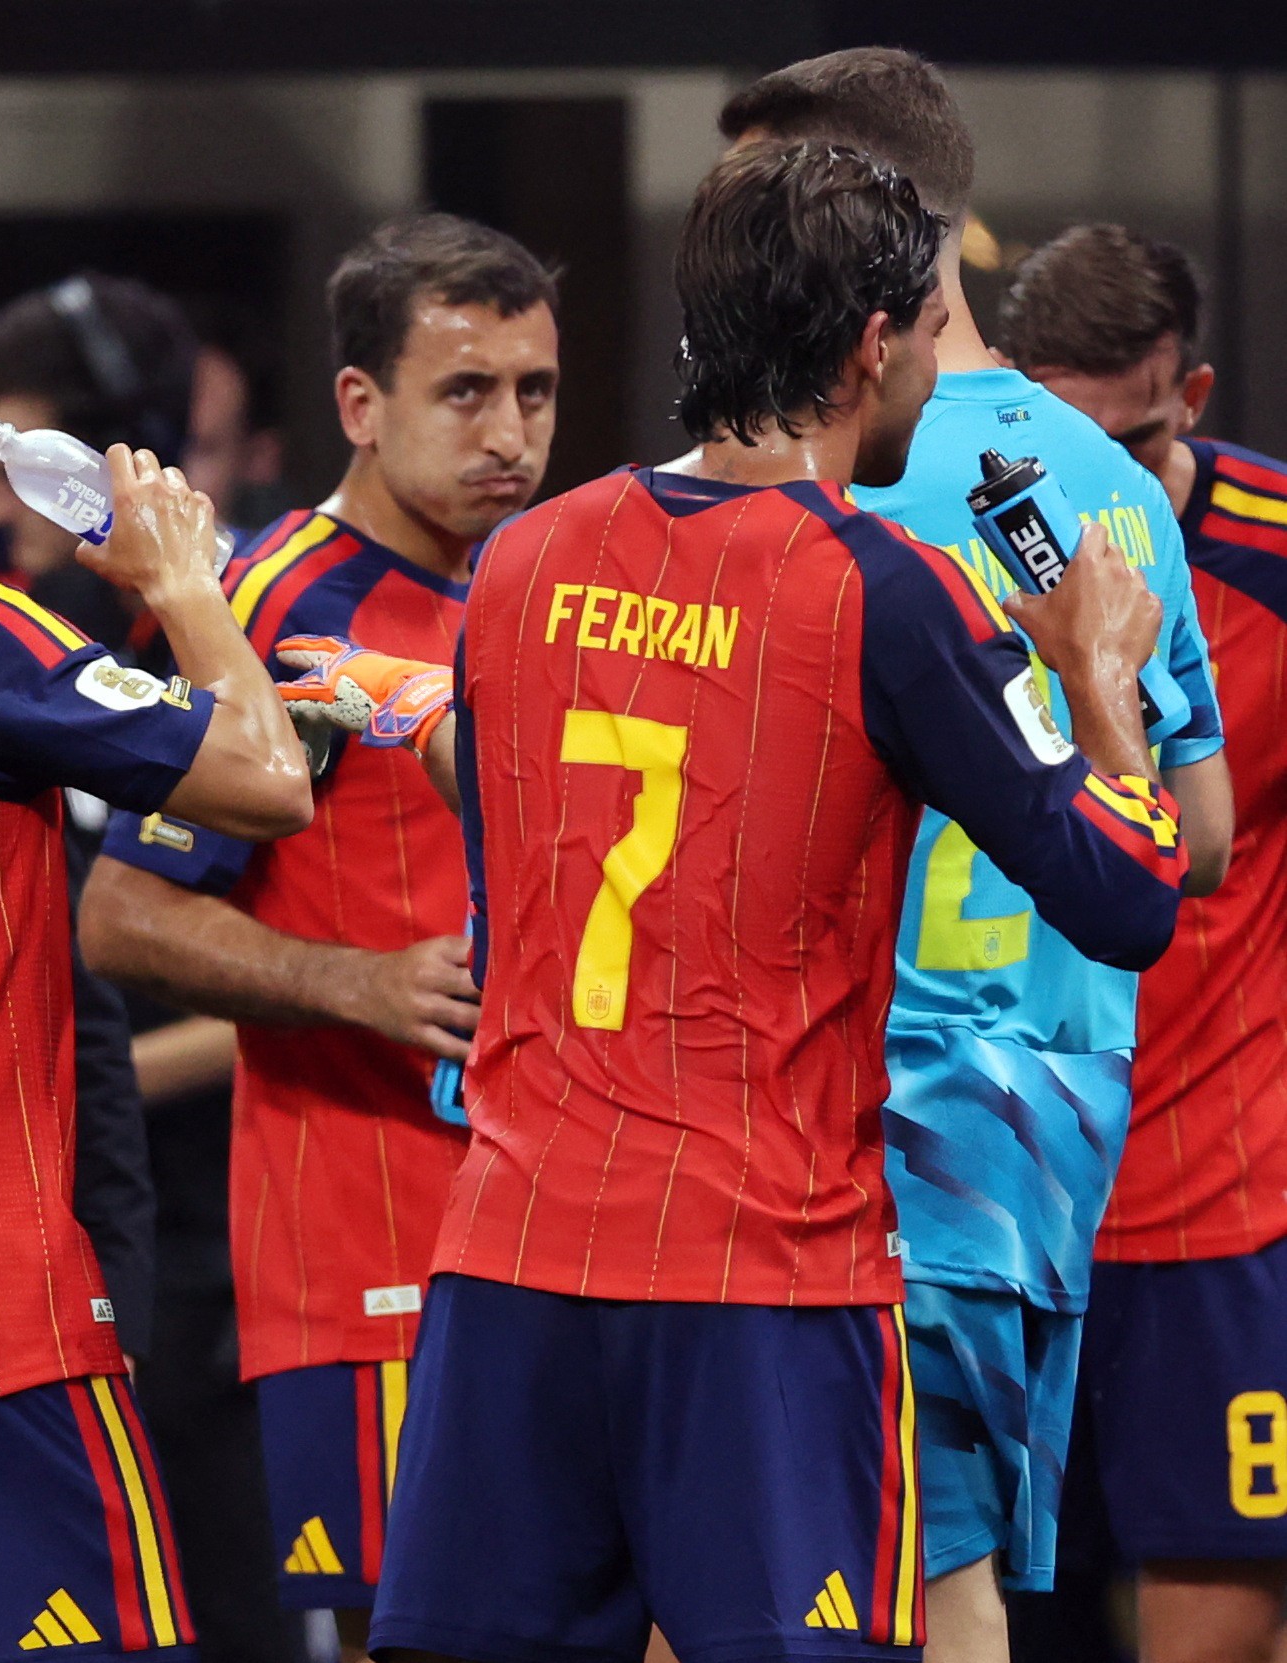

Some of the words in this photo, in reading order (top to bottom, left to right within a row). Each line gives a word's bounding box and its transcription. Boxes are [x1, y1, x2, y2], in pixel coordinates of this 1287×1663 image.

[63, 475, 107, 509] water
[1009, 514, 1066, 594] ADE
[545, 583, 740, 670] FERRAN
[560, 709, 688, 1031] 7
[1226, 1390, 1287, 1519] 8
